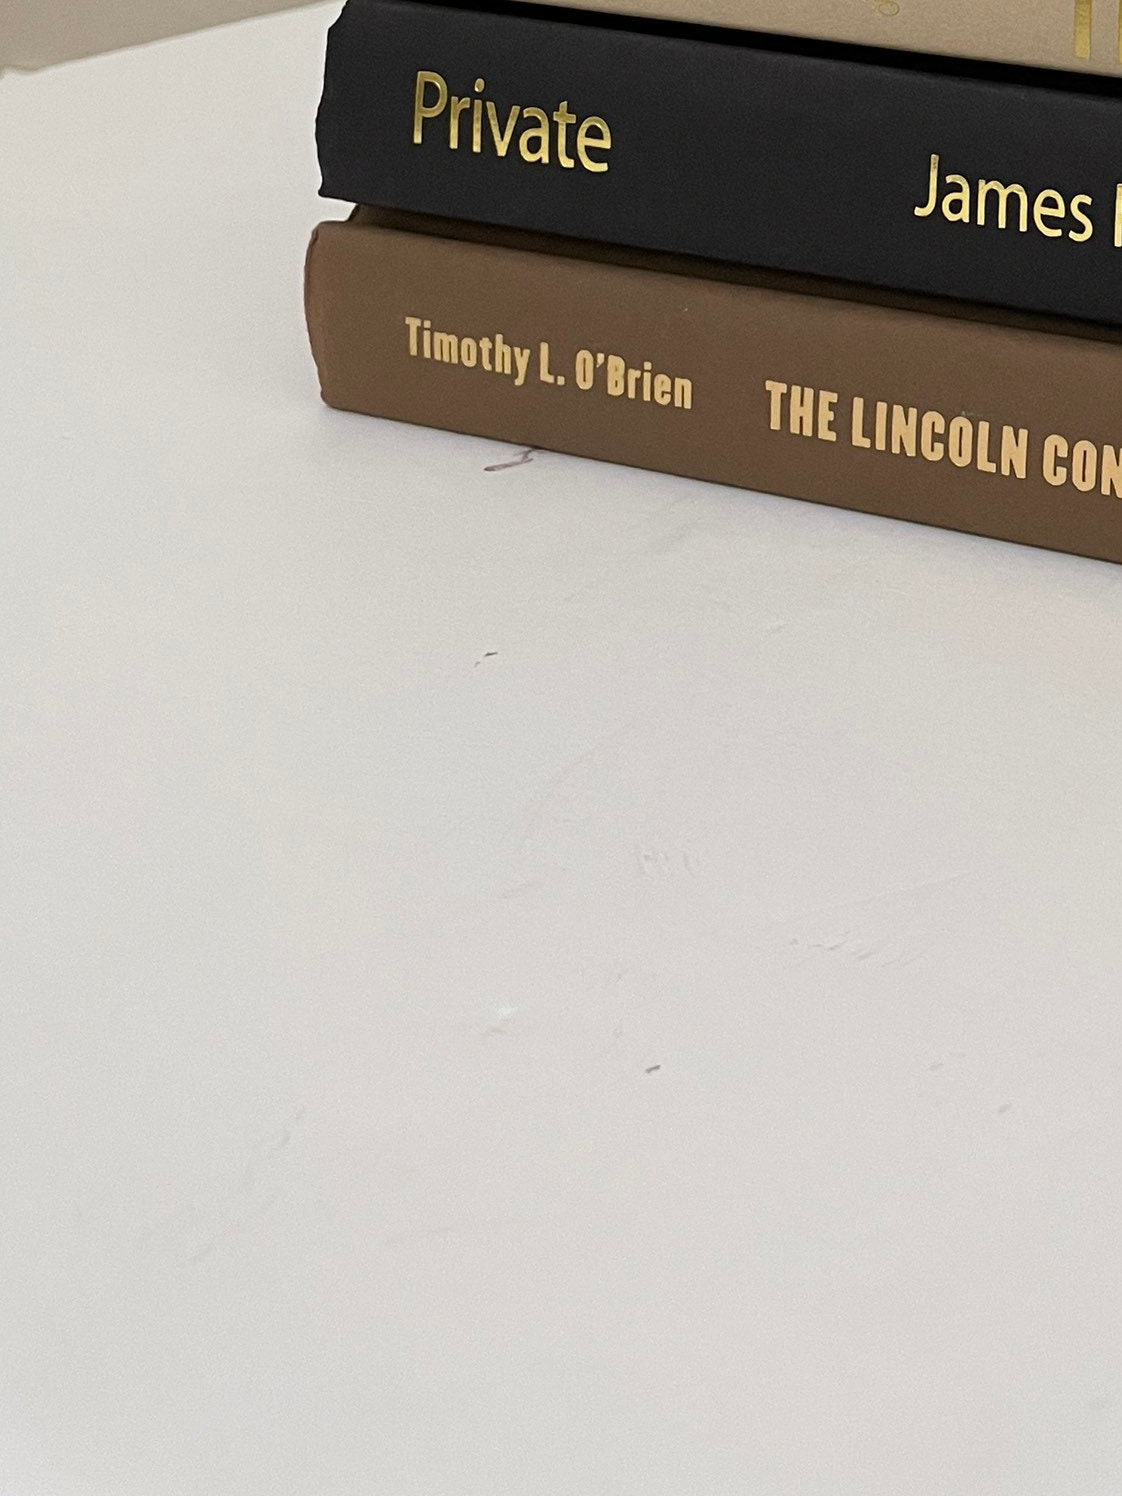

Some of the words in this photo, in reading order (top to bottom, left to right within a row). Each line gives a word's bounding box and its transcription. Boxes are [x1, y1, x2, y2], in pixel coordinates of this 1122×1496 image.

[412, 70, 611, 173] Private
[914, 154, 1094, 242] James
[405, 316, 531, 386] Timothy
[539, 345, 565, 387] L.
[575, 350, 693, 410] O'Brien
[765, 379, 838, 442] THE
[851, 397, 1028, 480] LINCOLN
